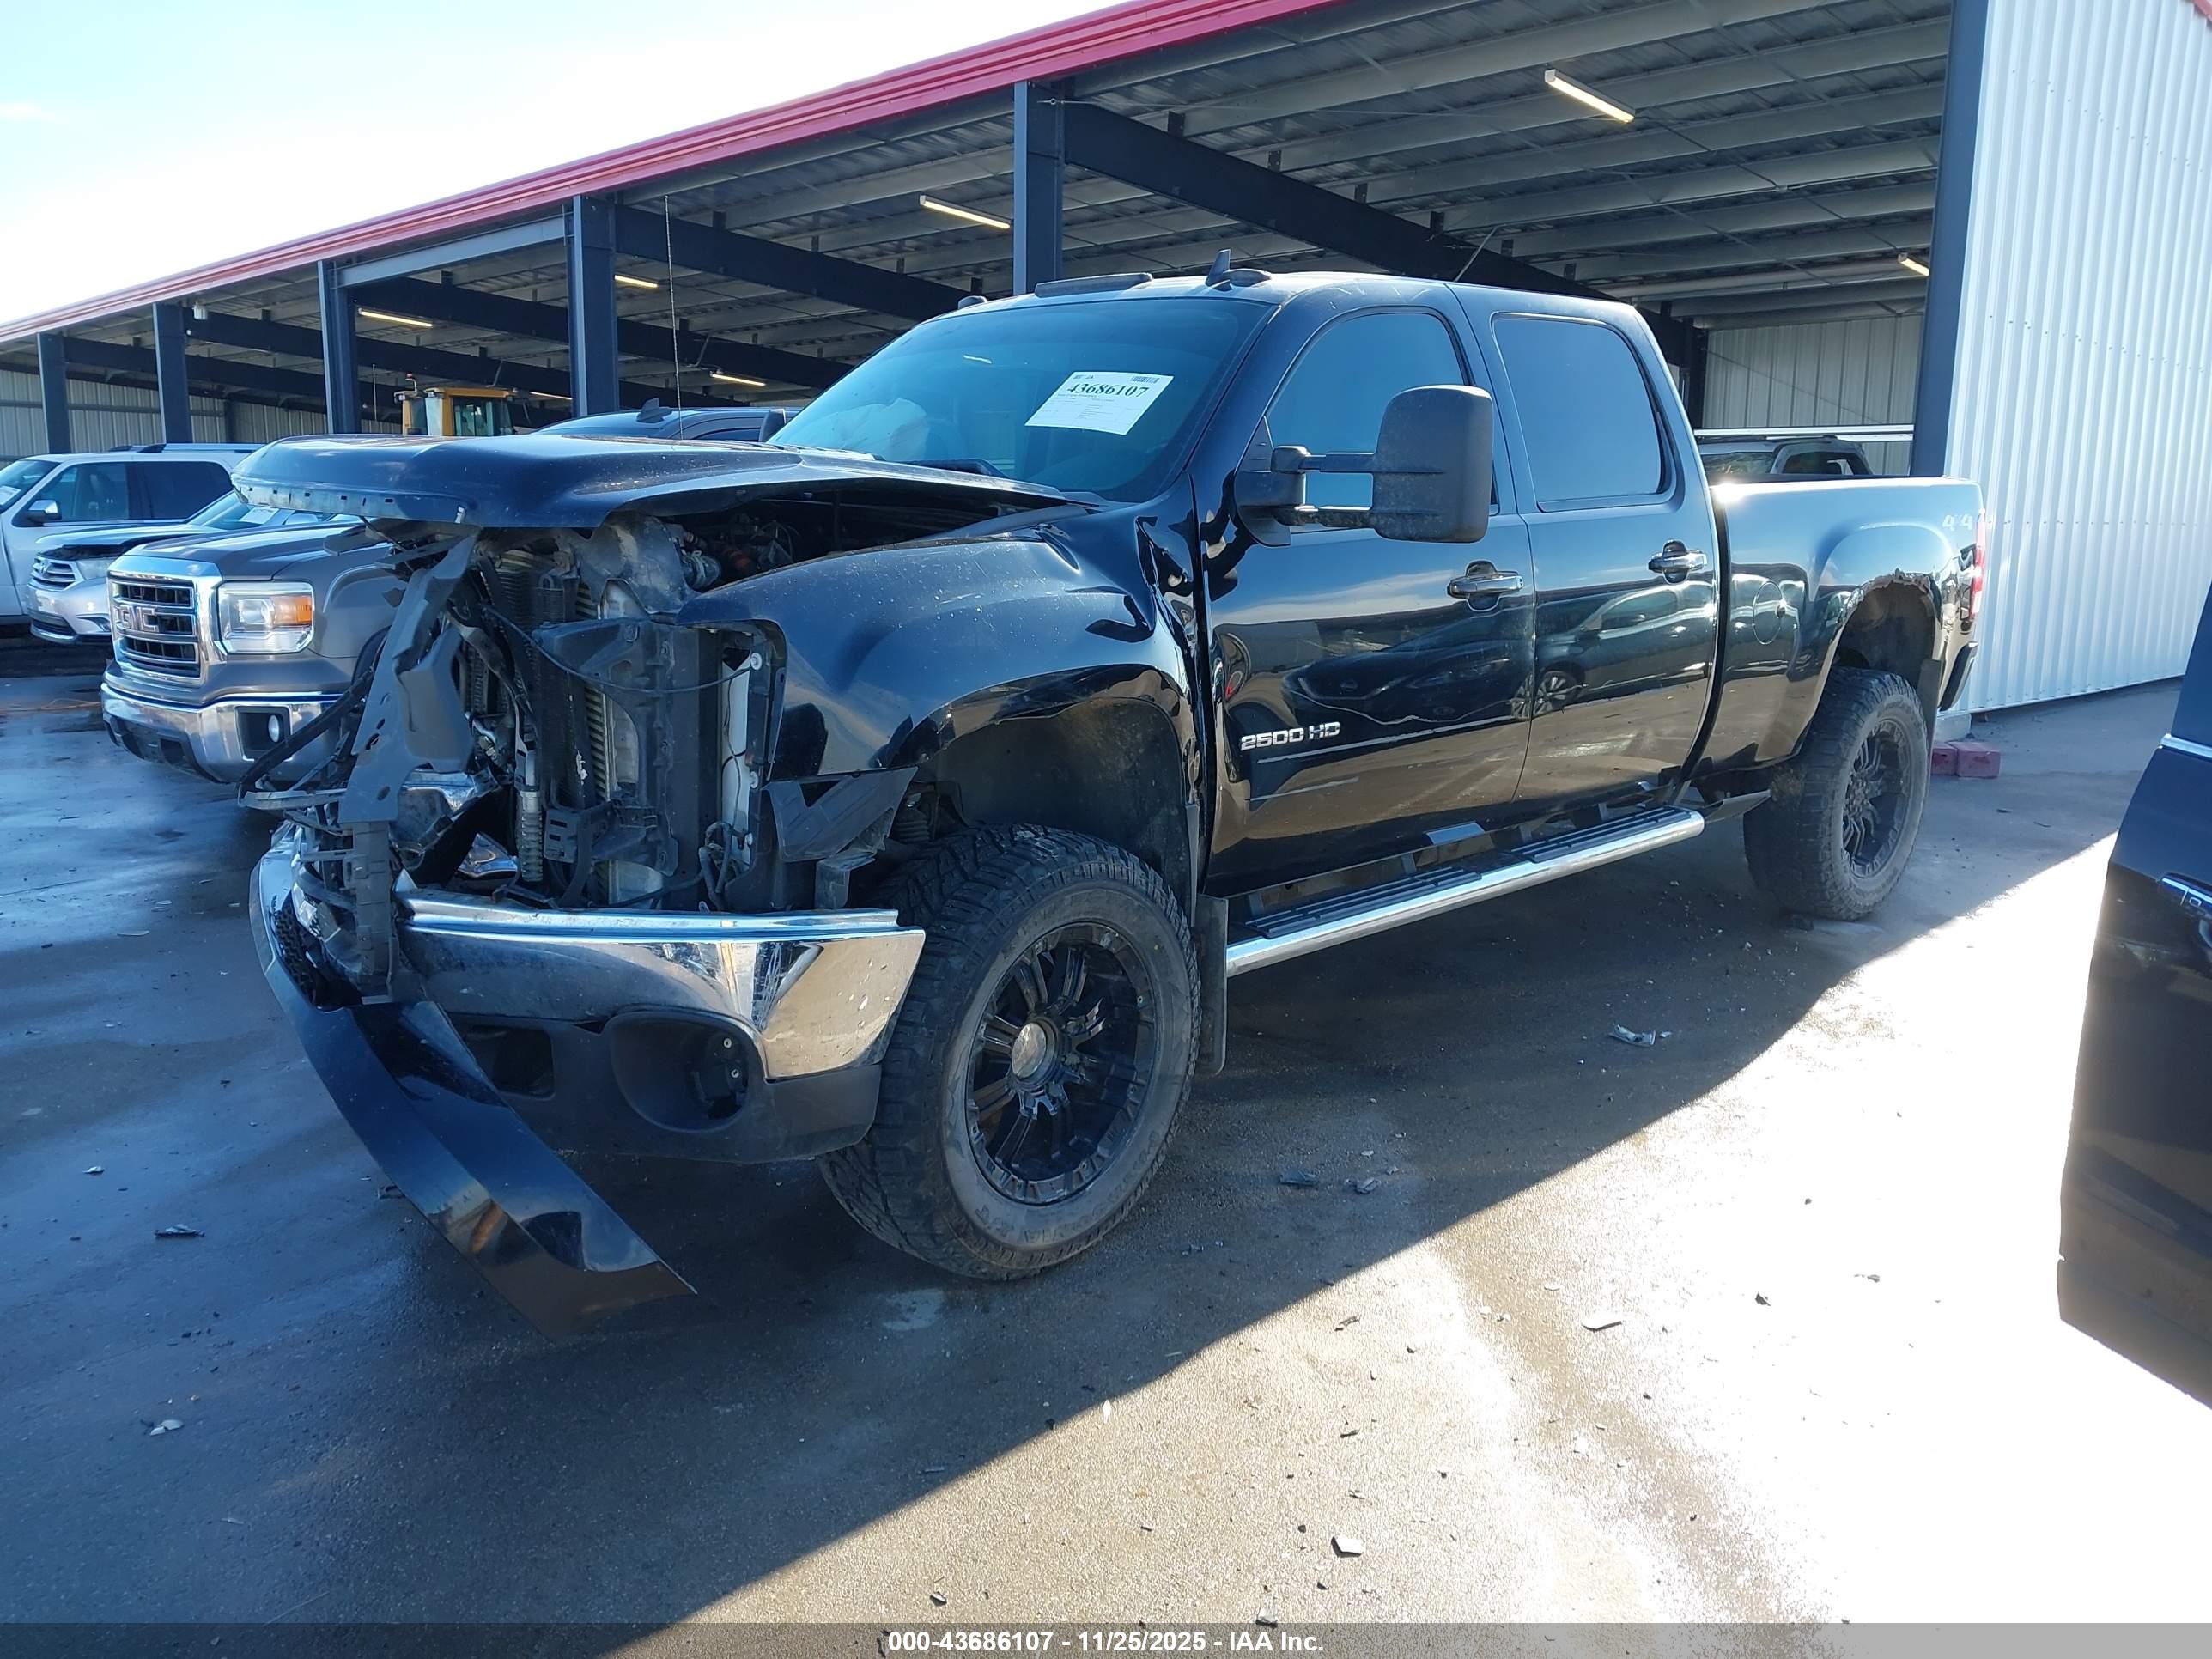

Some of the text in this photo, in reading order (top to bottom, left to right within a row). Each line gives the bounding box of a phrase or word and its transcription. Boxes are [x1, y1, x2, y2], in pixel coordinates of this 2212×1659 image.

[1067, 383, 1150, 398] 43686107
[118, 603, 160, 633] GMC
[1240, 721, 1341, 751] 2500 HD
